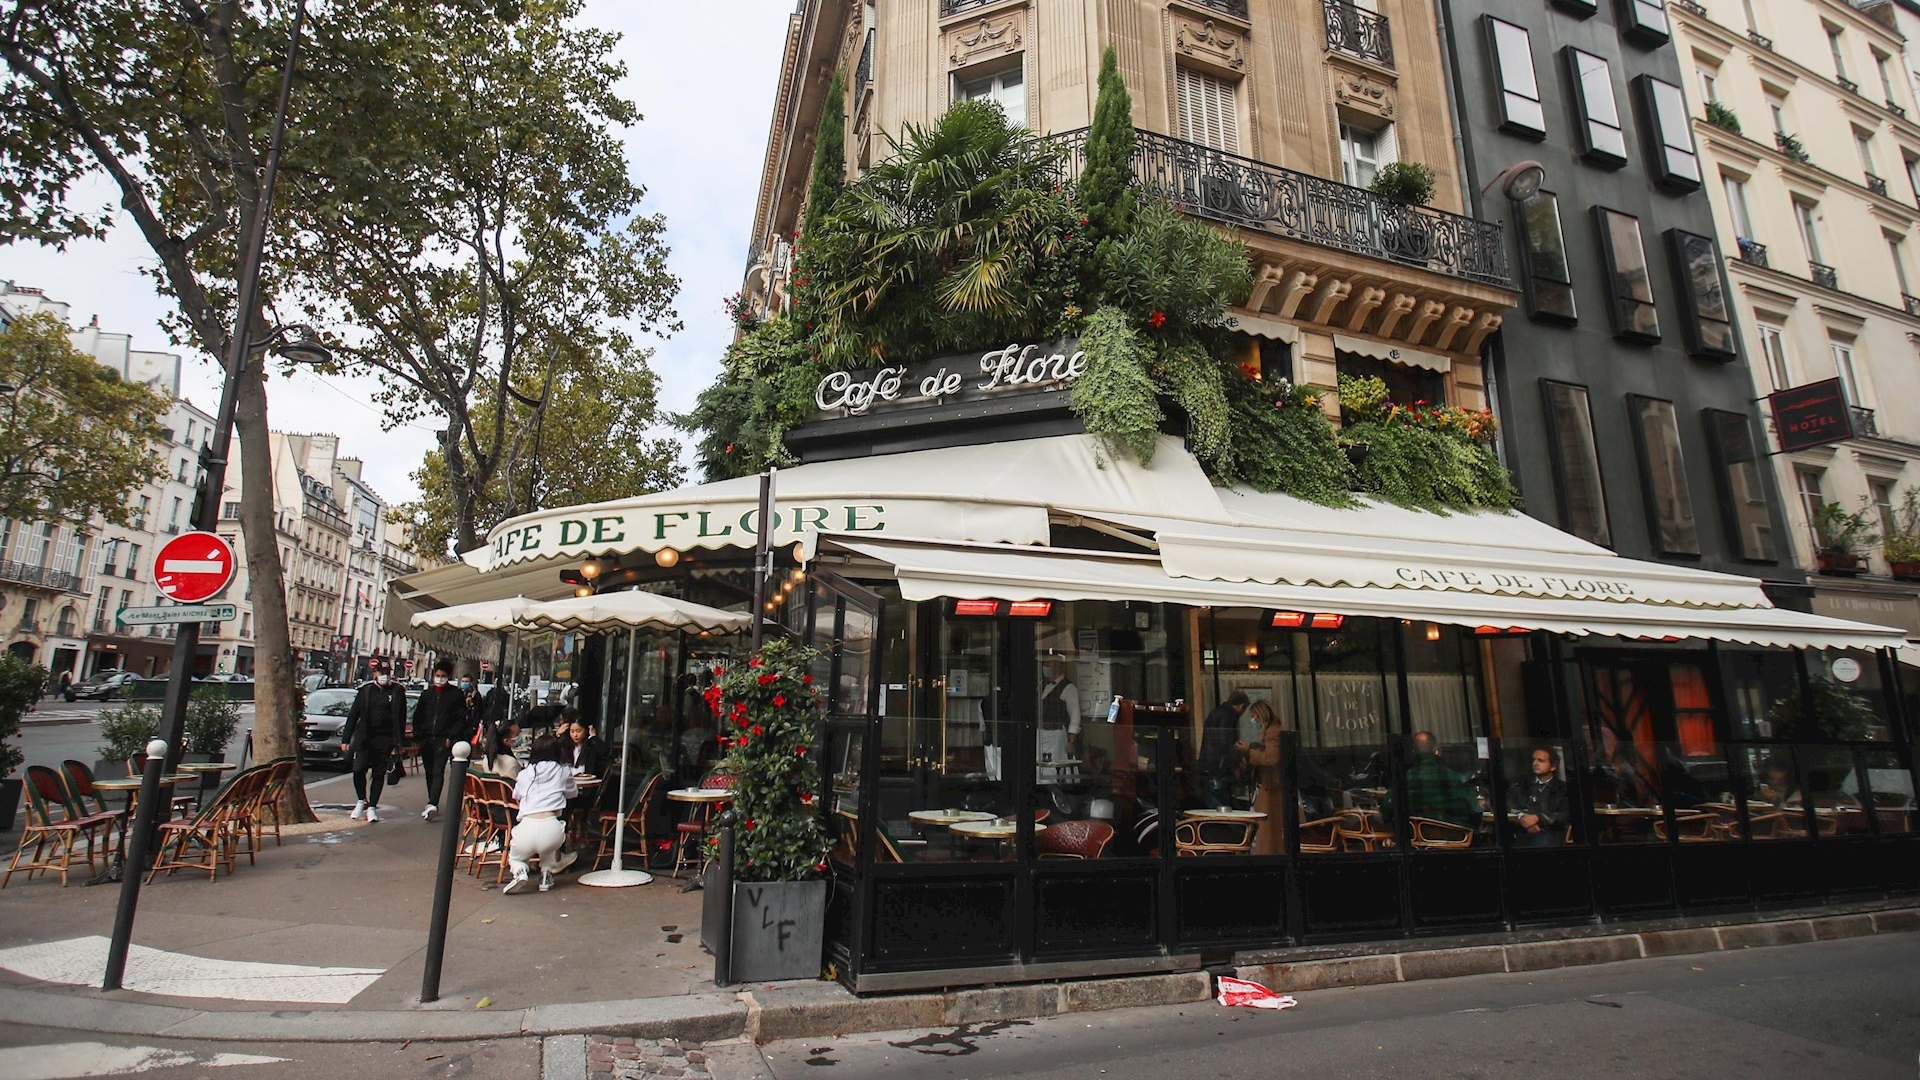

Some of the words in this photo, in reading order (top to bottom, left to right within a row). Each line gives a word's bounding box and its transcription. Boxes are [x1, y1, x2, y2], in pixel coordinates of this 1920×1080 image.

[815, 364, 907, 415] Café
[919, 367, 962, 398] de
[977, 343, 1089, 391] Flore
[1789, 415, 1837, 433] HOTEL
[558, 515, 626, 547] DE
[653, 504, 887, 541] FLORE
[1395, 567, 1482, 585] CAFE
[1490, 573, 1533, 588] DE
[1540, 577, 1634, 595] FLORE
[1328, 682, 1370, 697] CAFE
[1343, 701, 1359, 710] DE
